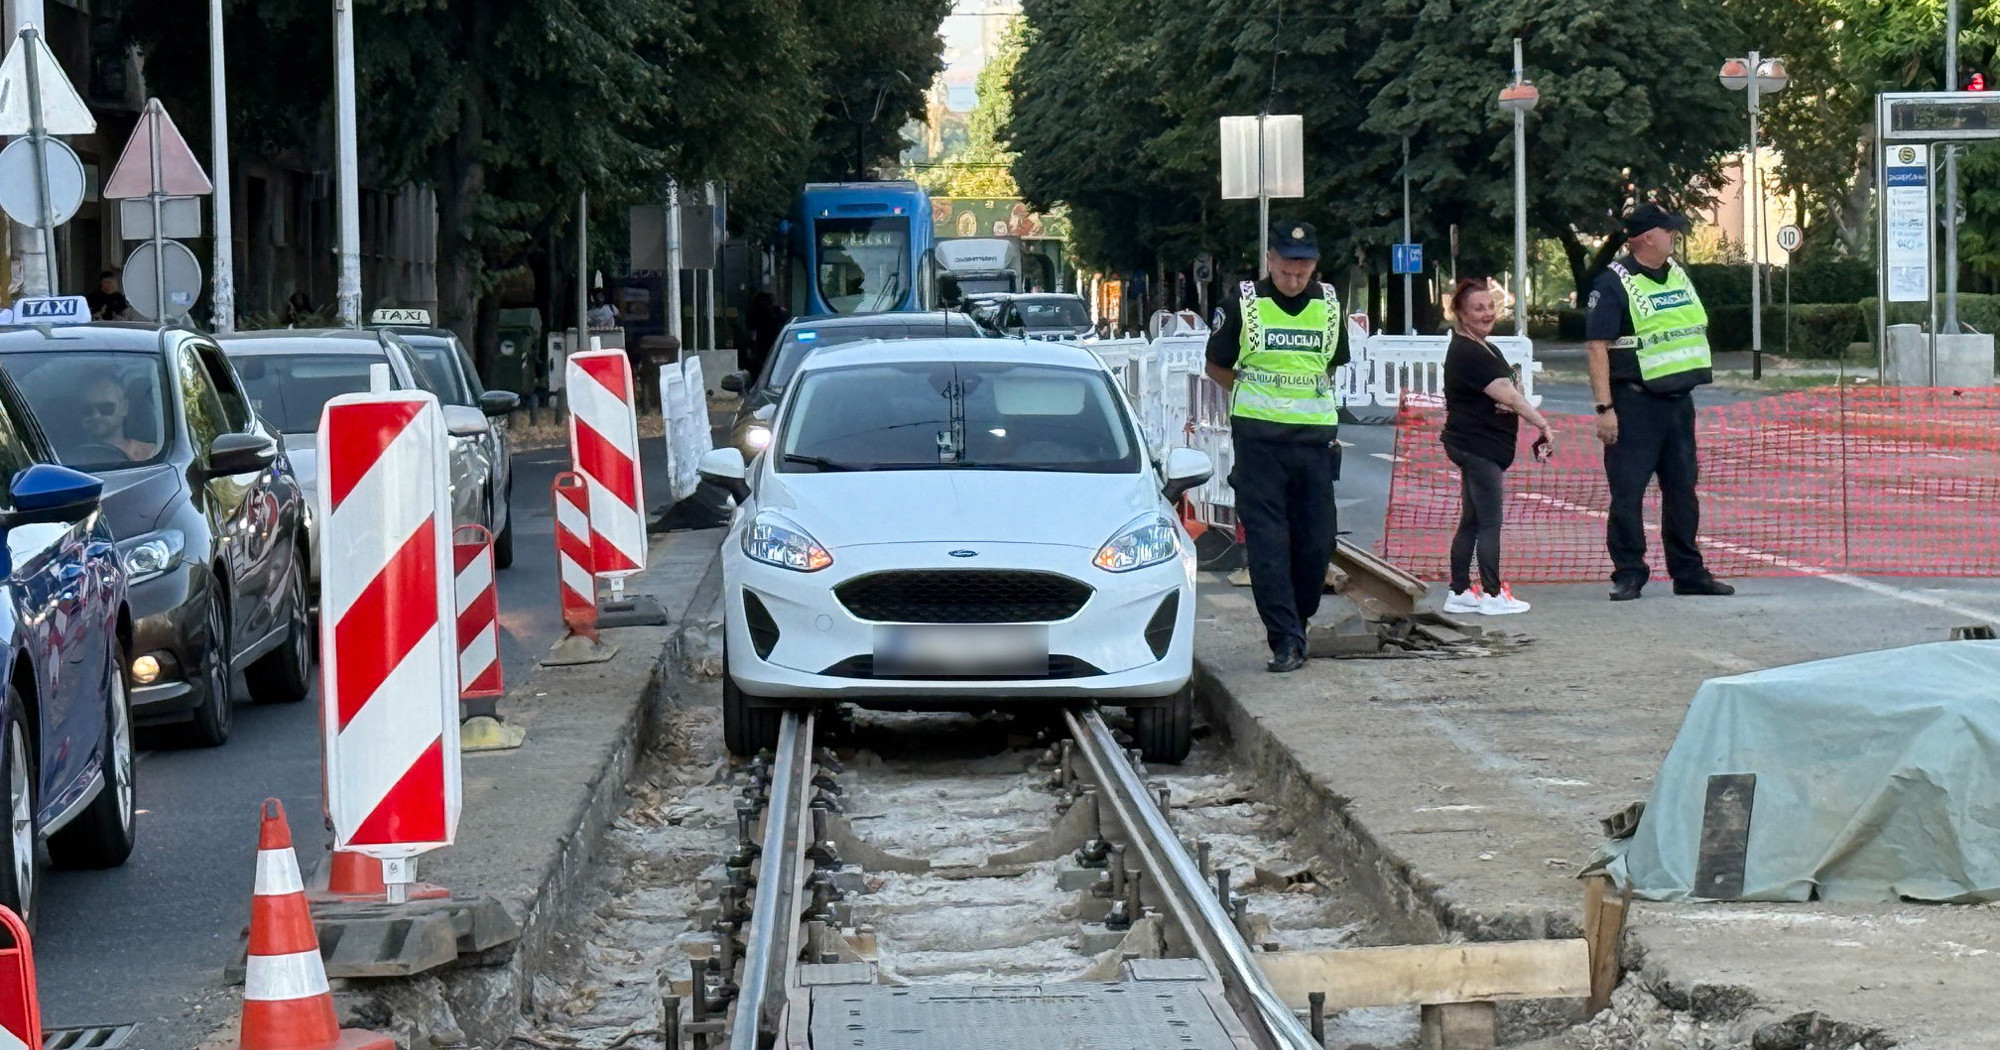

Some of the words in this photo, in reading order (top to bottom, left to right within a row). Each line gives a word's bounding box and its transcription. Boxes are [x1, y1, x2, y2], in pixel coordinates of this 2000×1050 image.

[1783, 231, 1796, 246] 10
[25, 300, 74, 315] TAXI
[380, 310, 421, 321] TAXI
[1267, 332, 1321, 348] POLICIJA
